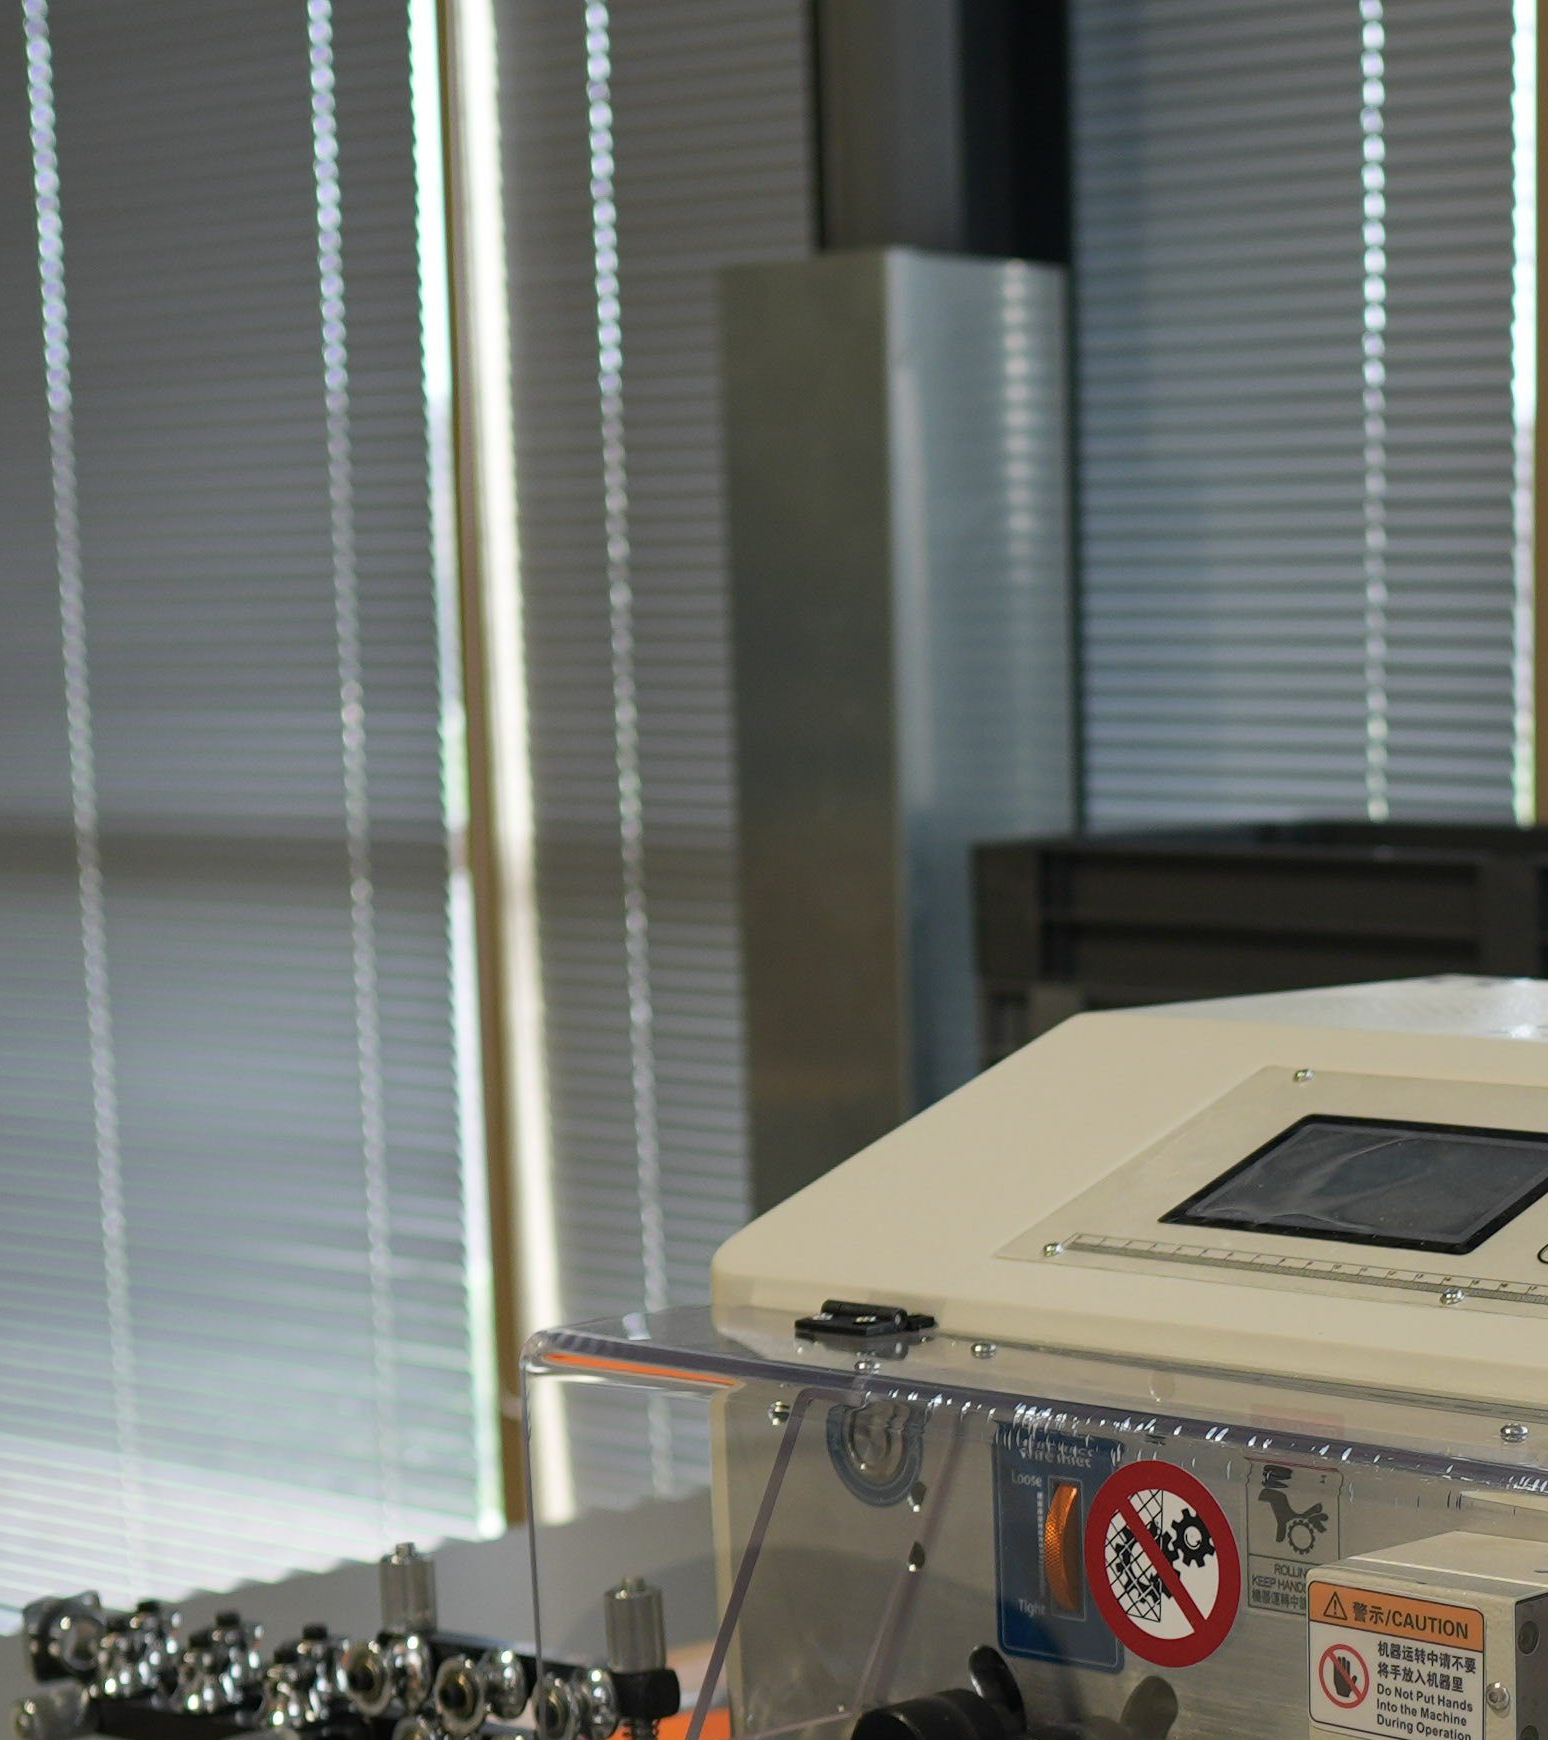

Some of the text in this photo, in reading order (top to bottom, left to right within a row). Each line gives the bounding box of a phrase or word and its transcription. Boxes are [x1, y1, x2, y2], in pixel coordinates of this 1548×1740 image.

[1011, 1470, 1042, 1487] Loose
[1274, 1563, 1306, 1578] ROLLIN
[1252, 1574, 1276, 1588] KEEP
[1019, 1599, 1046, 1616] Tight
[1378, 1641, 1476, 1675] 机器运转中请不要
[1377, 1662, 1464, 1693] 将手放入机器里
[1377, 1683, 1473, 1712] Do Not Put Hands
[1377, 1699, 1467, 1727] Into the Machine
[1377, 1714, 1413, 1734] During
